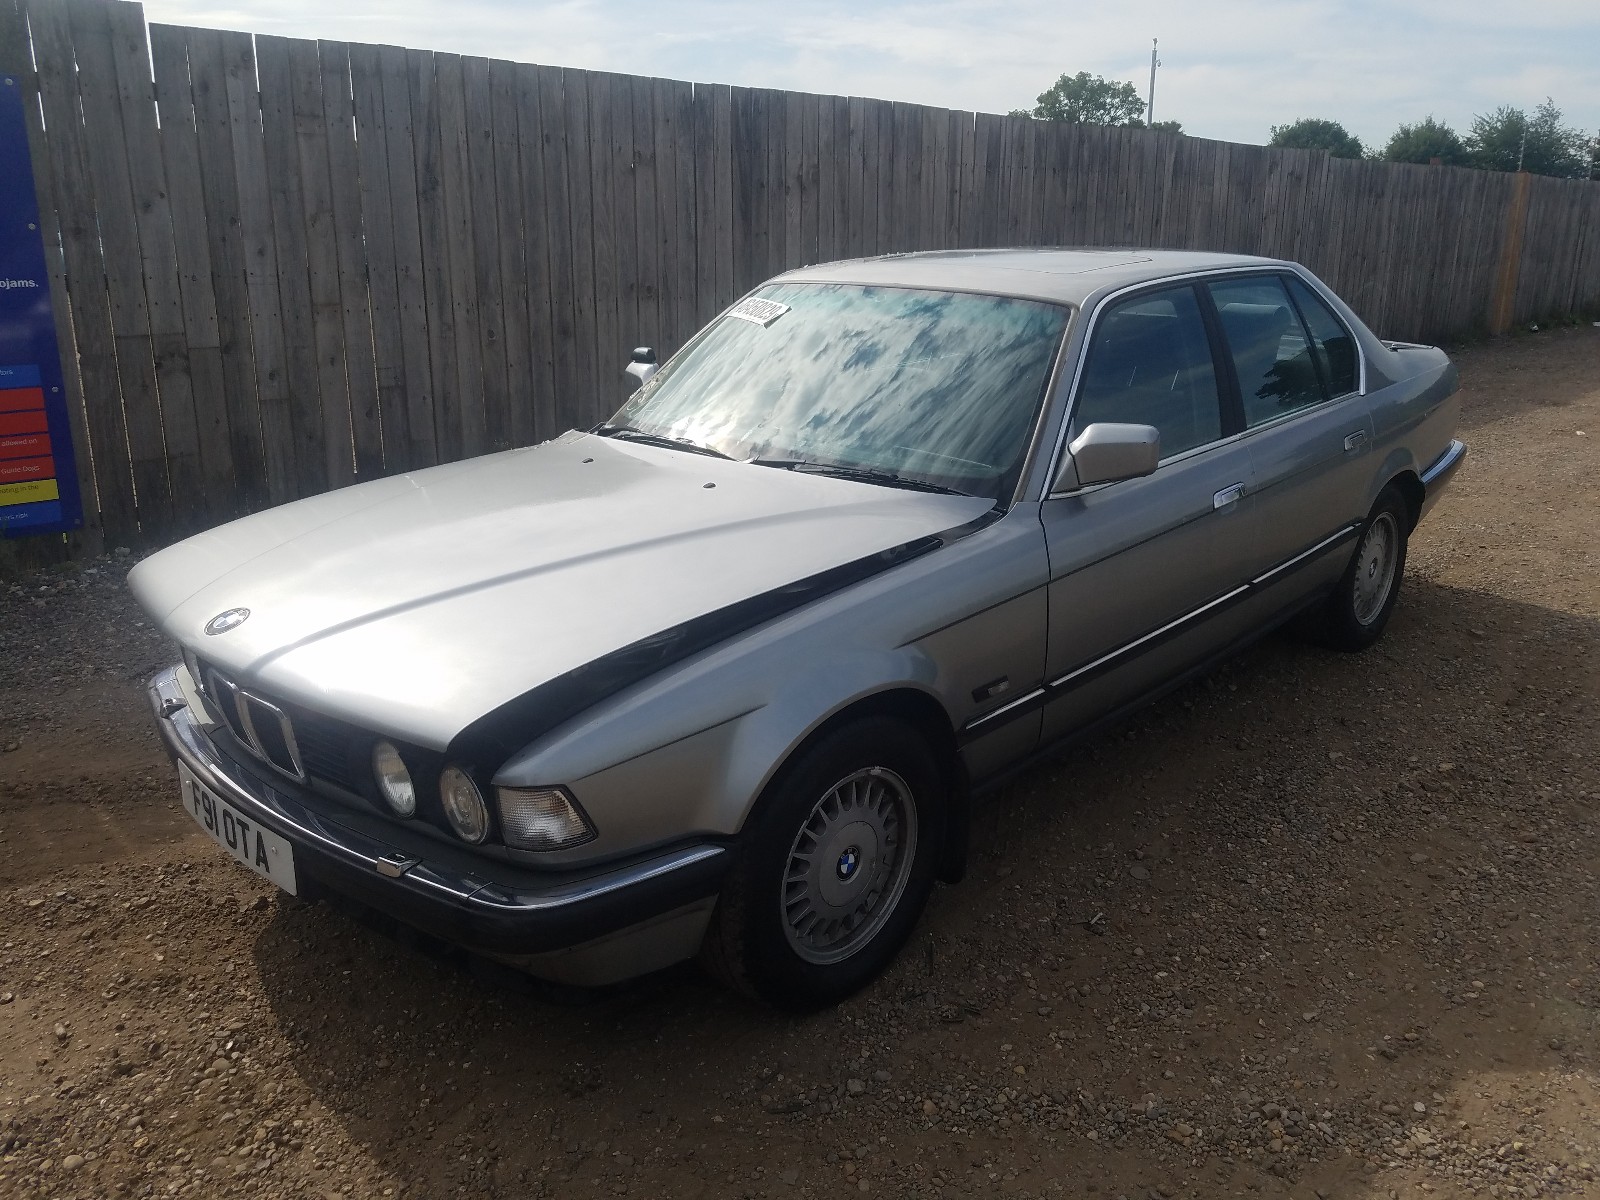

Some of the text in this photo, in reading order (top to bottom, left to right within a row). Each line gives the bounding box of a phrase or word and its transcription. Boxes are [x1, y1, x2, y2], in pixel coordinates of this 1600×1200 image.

[1, 438, 28, 447] allowed
[0, 465, 40, 475] Guide Dogs
